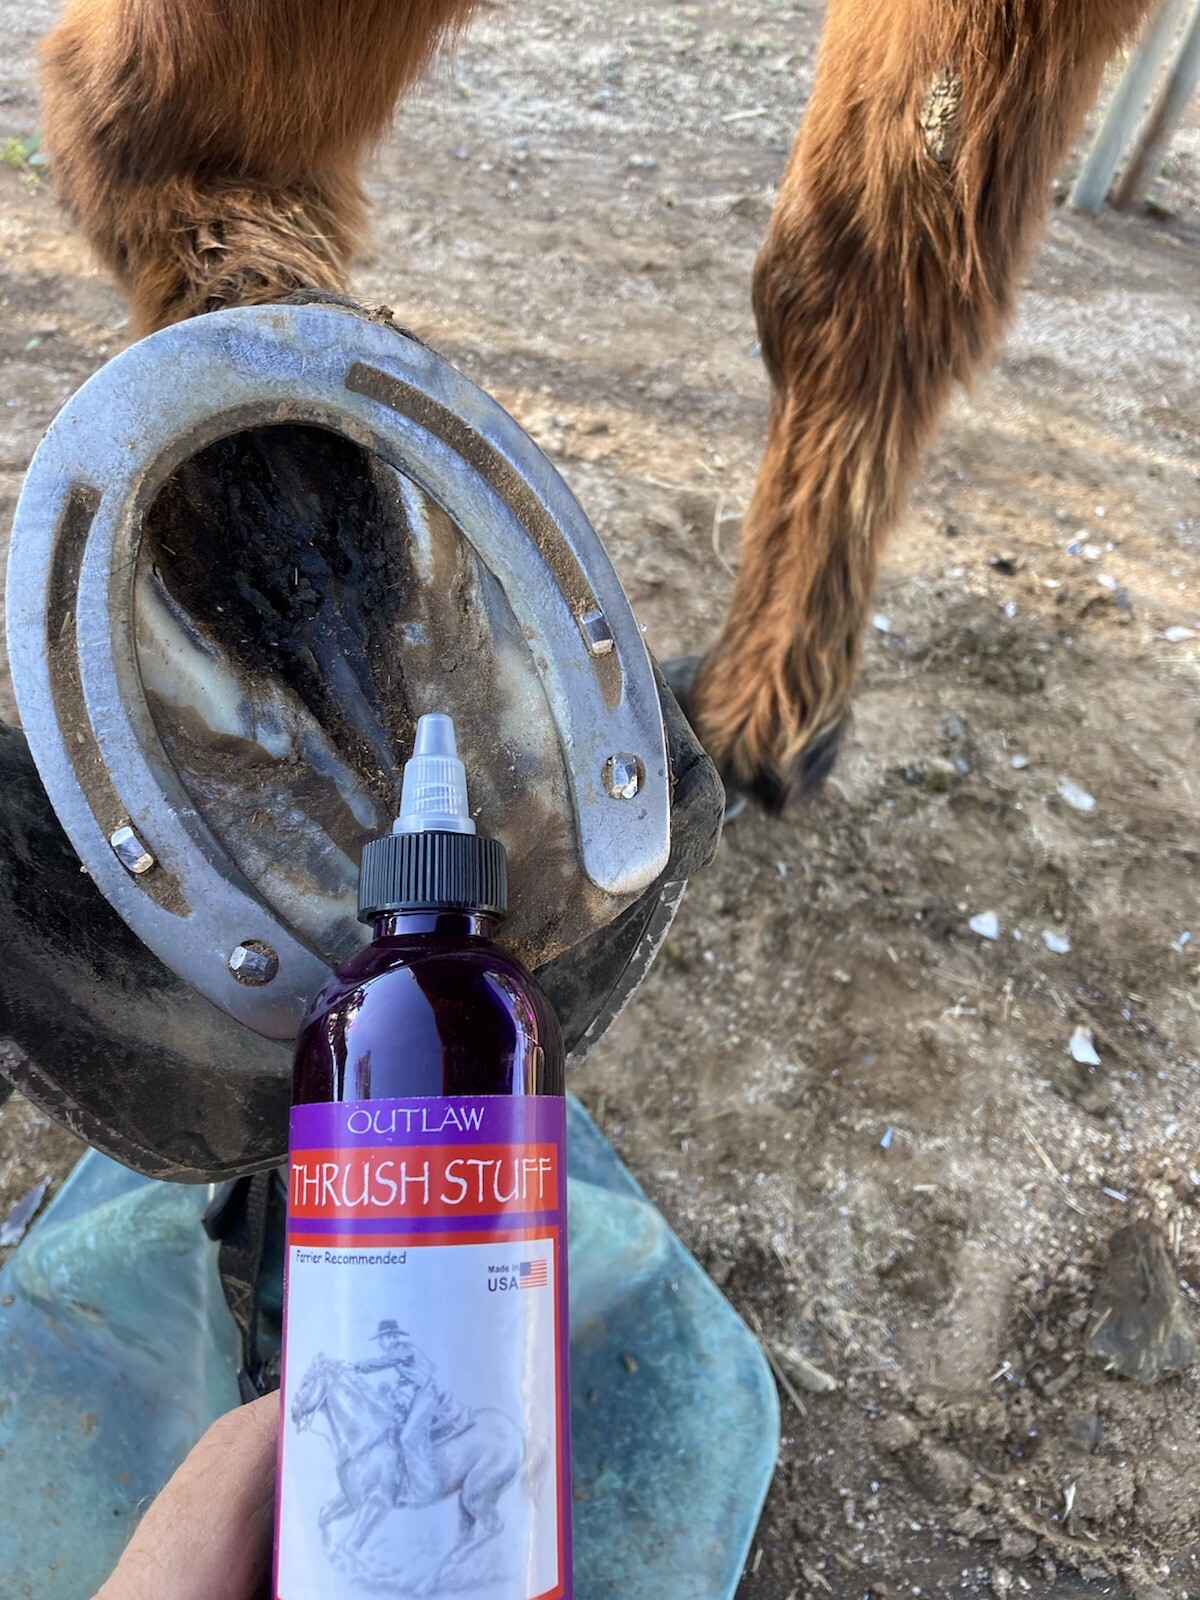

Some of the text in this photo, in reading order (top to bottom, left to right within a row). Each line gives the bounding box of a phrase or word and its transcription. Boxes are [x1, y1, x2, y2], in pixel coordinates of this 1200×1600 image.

[347, 1106, 485, 1134] OUTLAW
[292, 1157, 552, 1207] THRUSH STUFF
[296, 1250, 406, 1265] Farrier Recommended
[488, 1264, 519, 1273] Made in
[488, 1277, 519, 1292] USA
